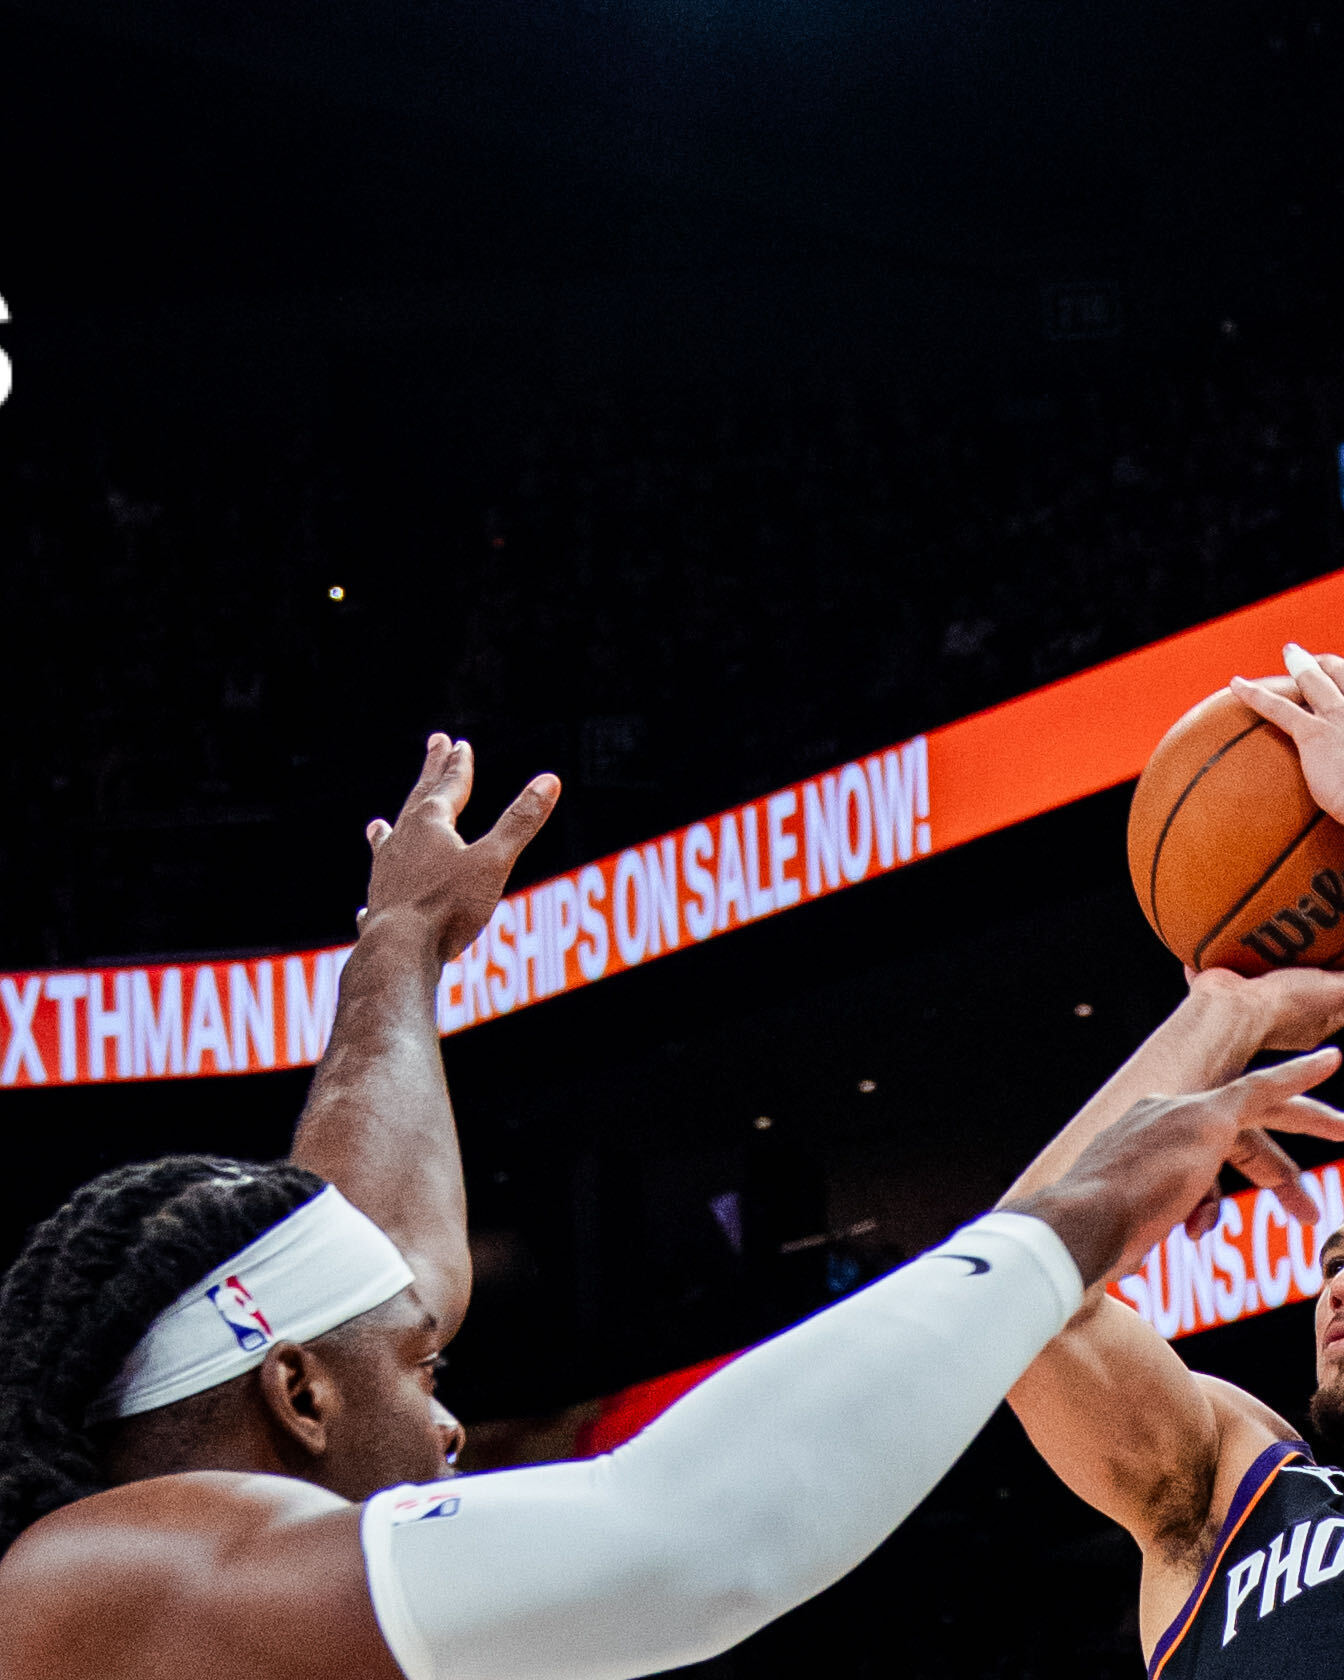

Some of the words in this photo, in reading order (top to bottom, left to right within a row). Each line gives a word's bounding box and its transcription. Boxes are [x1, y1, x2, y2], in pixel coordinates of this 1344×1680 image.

[611, 834, 682, 968] ON
[681, 787, 803, 942] SALE
[801, 733, 933, 897] NOW!
